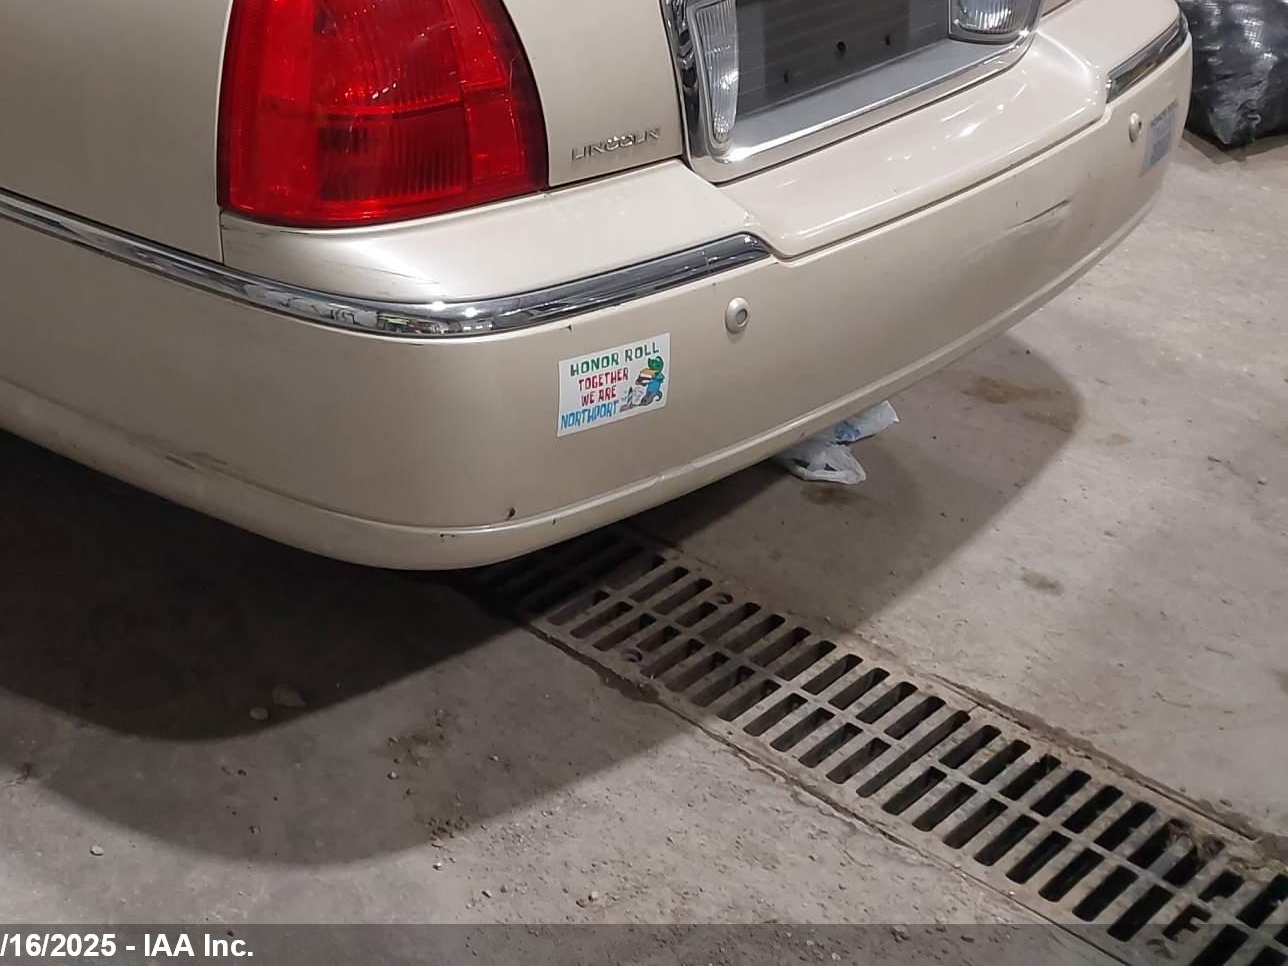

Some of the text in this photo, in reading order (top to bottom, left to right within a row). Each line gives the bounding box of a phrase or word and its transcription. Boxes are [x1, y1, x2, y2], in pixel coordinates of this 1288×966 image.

[571, 127, 660, 161] LINCOLN
[570, 342, 660, 377] HONOR ROLL
[579, 367, 629, 391] TOGETHER
[581, 385, 617, 407] WE ARE
[560, 400, 619, 430] NORTHPORT
